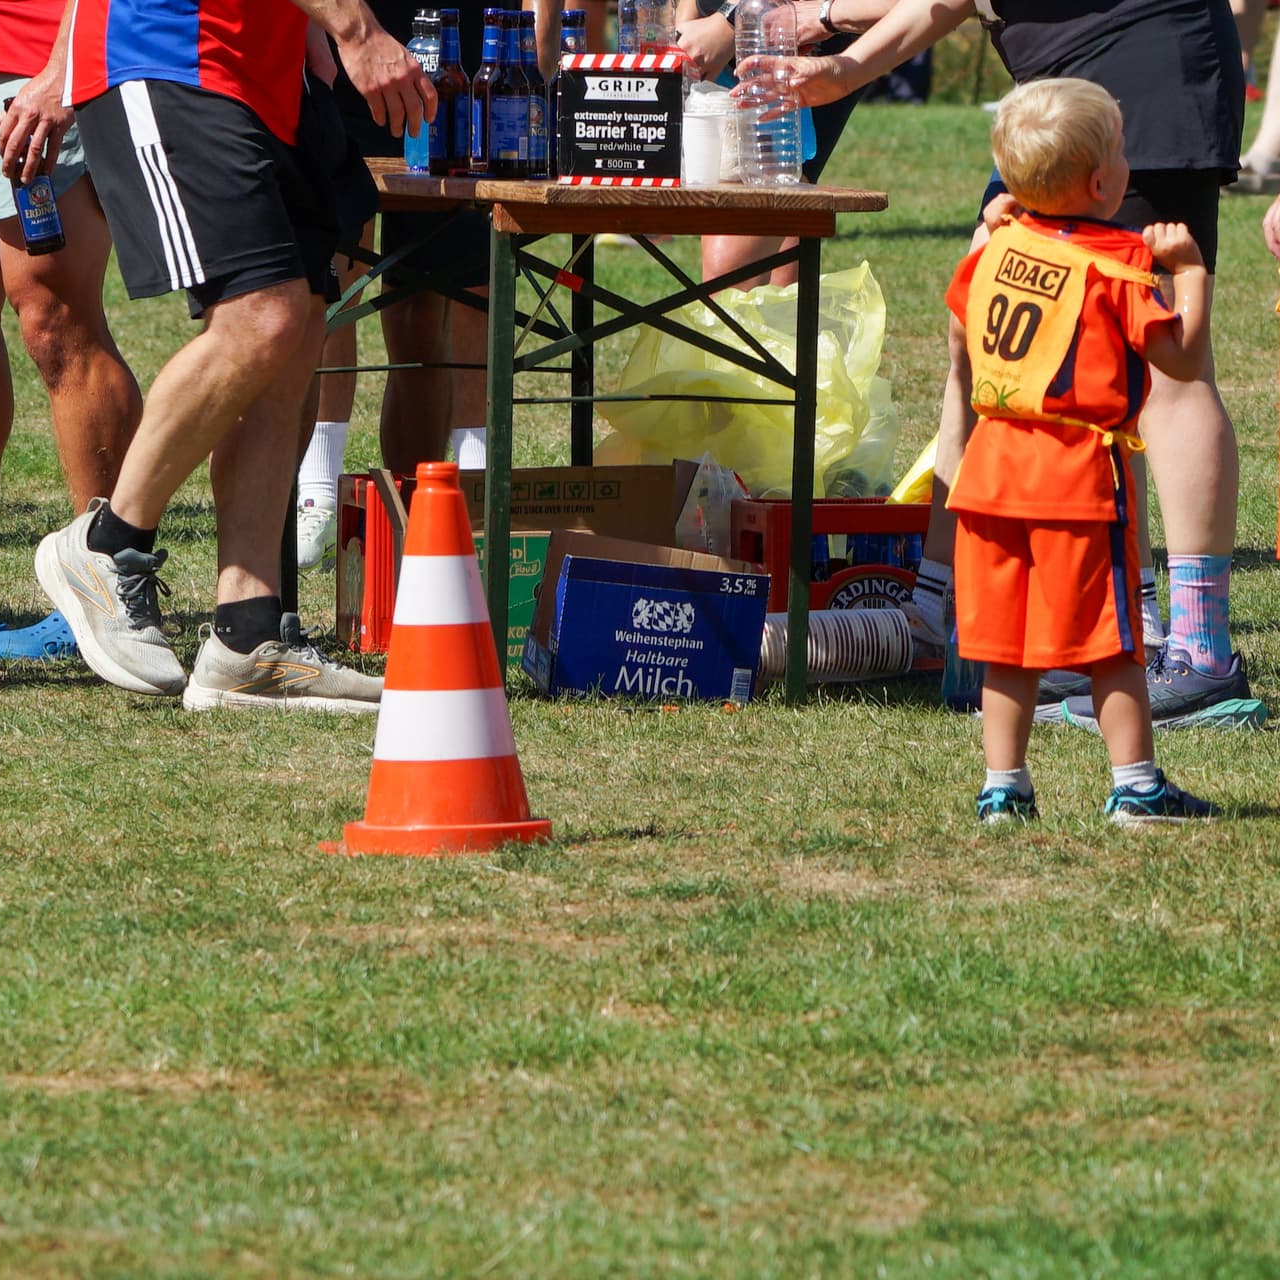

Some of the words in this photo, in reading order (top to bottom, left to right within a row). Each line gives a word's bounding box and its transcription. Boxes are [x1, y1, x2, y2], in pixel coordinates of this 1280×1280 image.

[598, 80, 645, 92] GRIP
[574, 111, 623, 122] extremely
[624, 111, 669, 124] tearproof
[575, 121, 627, 139] Barrier
[630, 122, 666, 143] Tape
[599, 142, 642, 152] red/white
[1001, 255, 1060, 291] ADAC
[982, 293, 1043, 362] 90
[831, 577, 913, 609] ERDINGE
[615, 629, 705, 650] Weihenstephan
[625, 649, 689, 668] Haltbare
[614, 665, 694, 698] Milch
